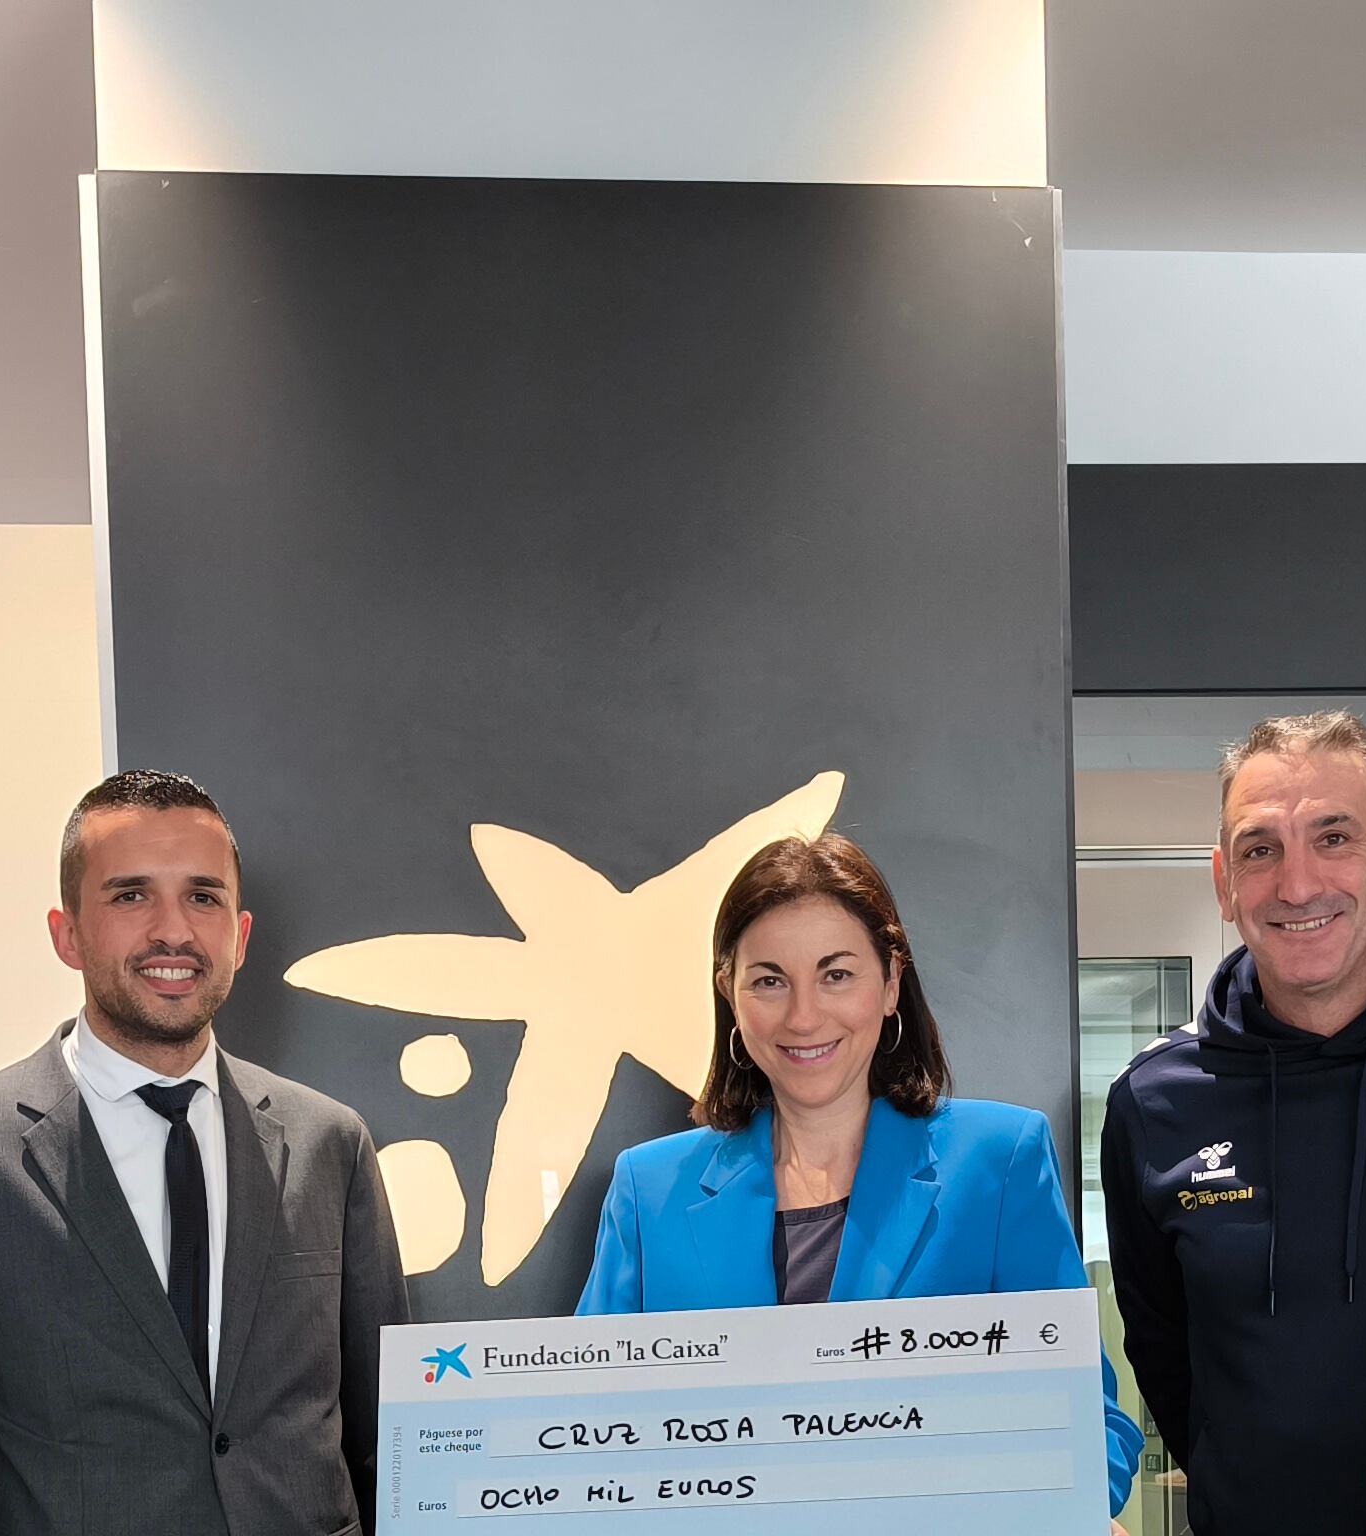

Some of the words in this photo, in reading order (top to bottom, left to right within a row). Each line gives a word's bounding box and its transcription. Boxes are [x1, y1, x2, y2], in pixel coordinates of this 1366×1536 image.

[1198, 1186, 1253, 1204] agropal
[1039, 1323, 1059, 1345] €
[482, 1343, 611, 1369] Fundación
[816, 1348, 845, 1358] Euros
[419, 1429, 463, 1441] Páguese
[465, 1428, 484, 1439] por
[538, 1423, 640, 1450] CRUZ
[663, 1417, 754, 1443] ROJA
[419, 1444, 441, 1453] este
[444, 1442, 482, 1453] cheque
[481, 1485, 559, 1510] OCHO
[657, 1475, 756, 1499] EUROS
[391, 1496, 401, 1519] Serie
[418, 1502, 447, 1511] Euros
